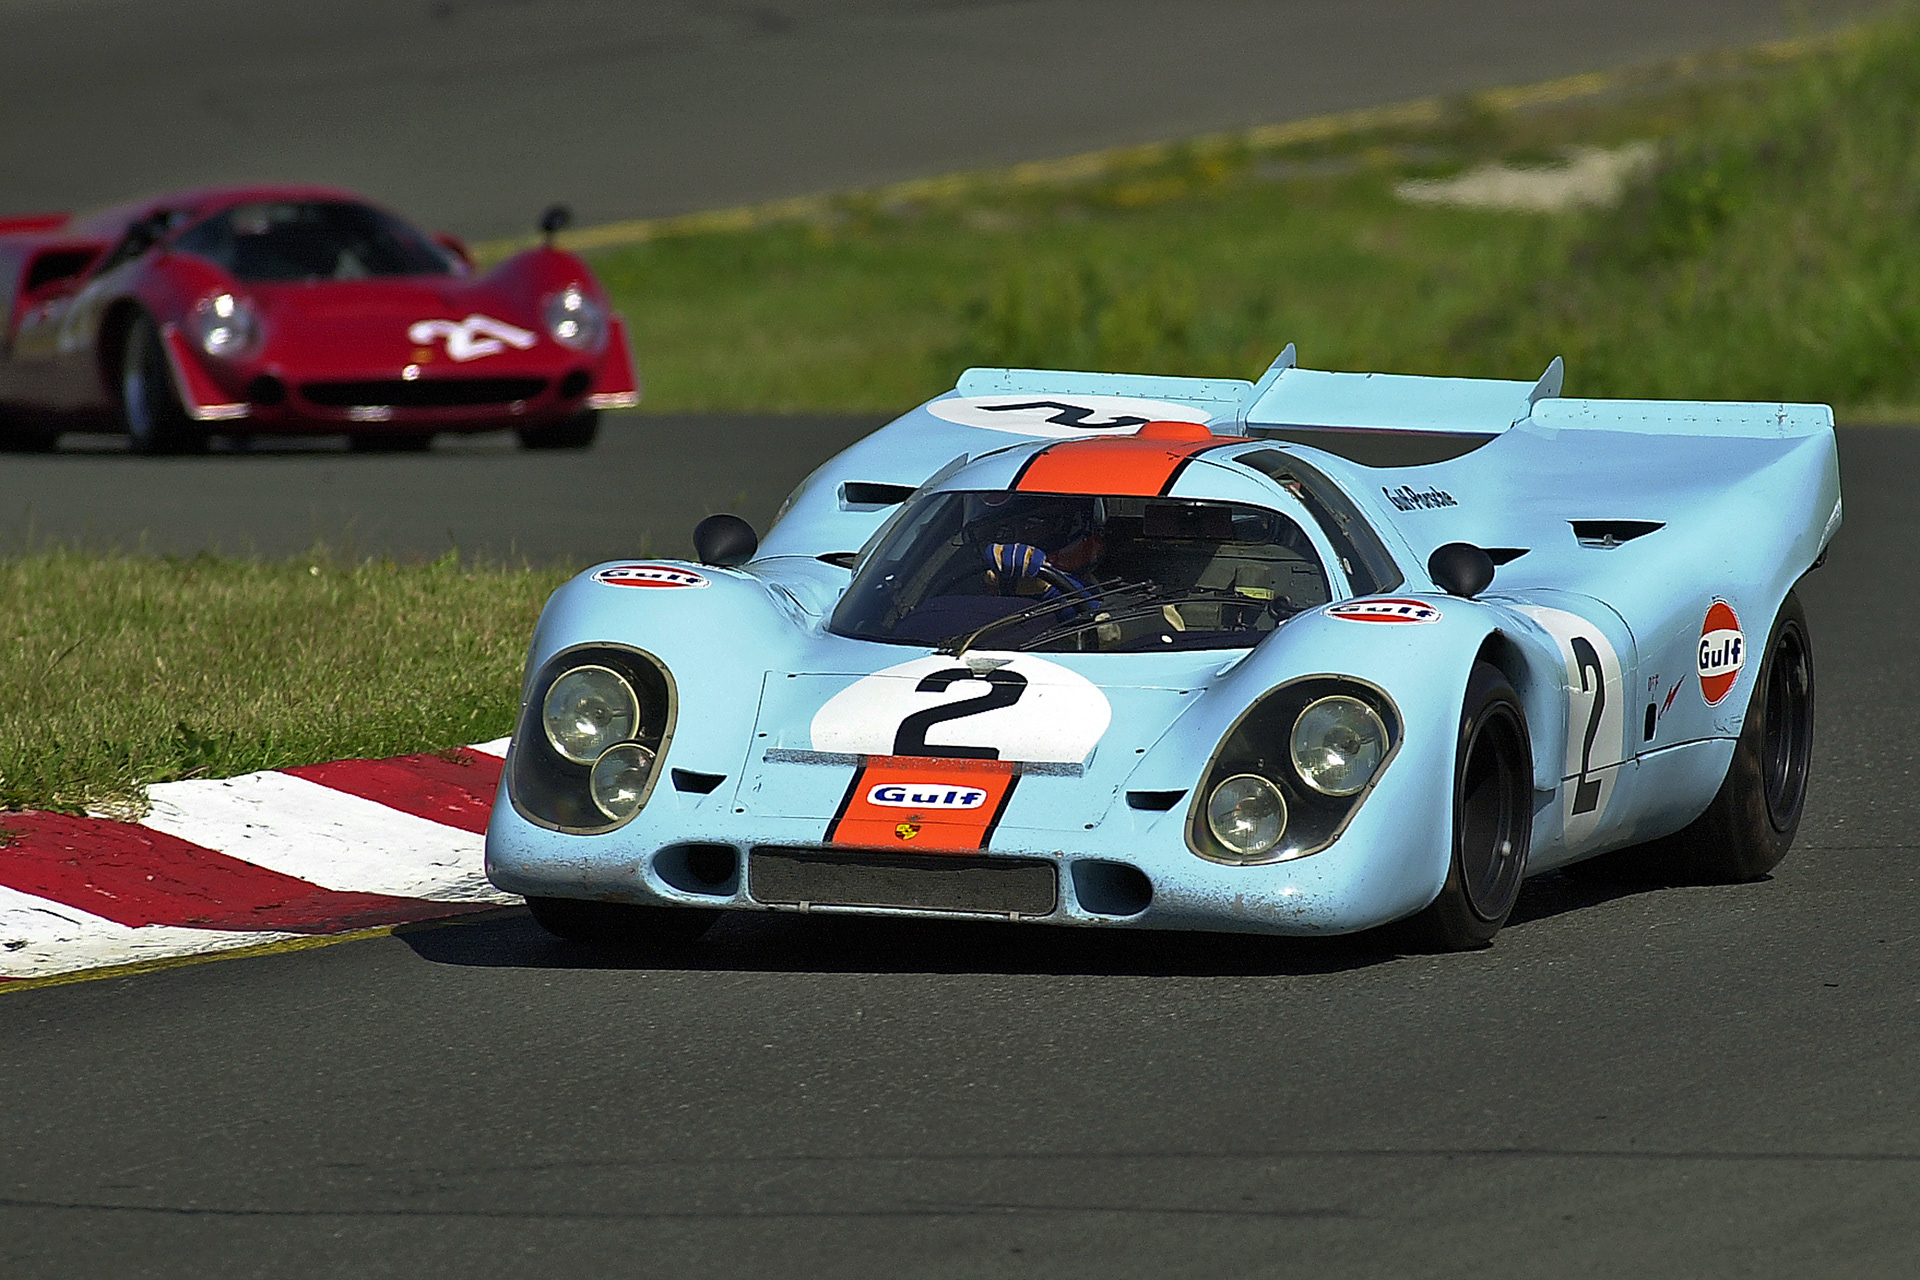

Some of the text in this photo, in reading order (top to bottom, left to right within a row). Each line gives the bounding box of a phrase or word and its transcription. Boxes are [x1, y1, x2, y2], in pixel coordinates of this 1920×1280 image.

[973, 401, 1150, 428] 2
[1700, 638, 1742, 669] Gulf
[892, 668, 1028, 760] 2
[1571, 637, 1606, 815] 2
[874, 787, 982, 804] Gulf
